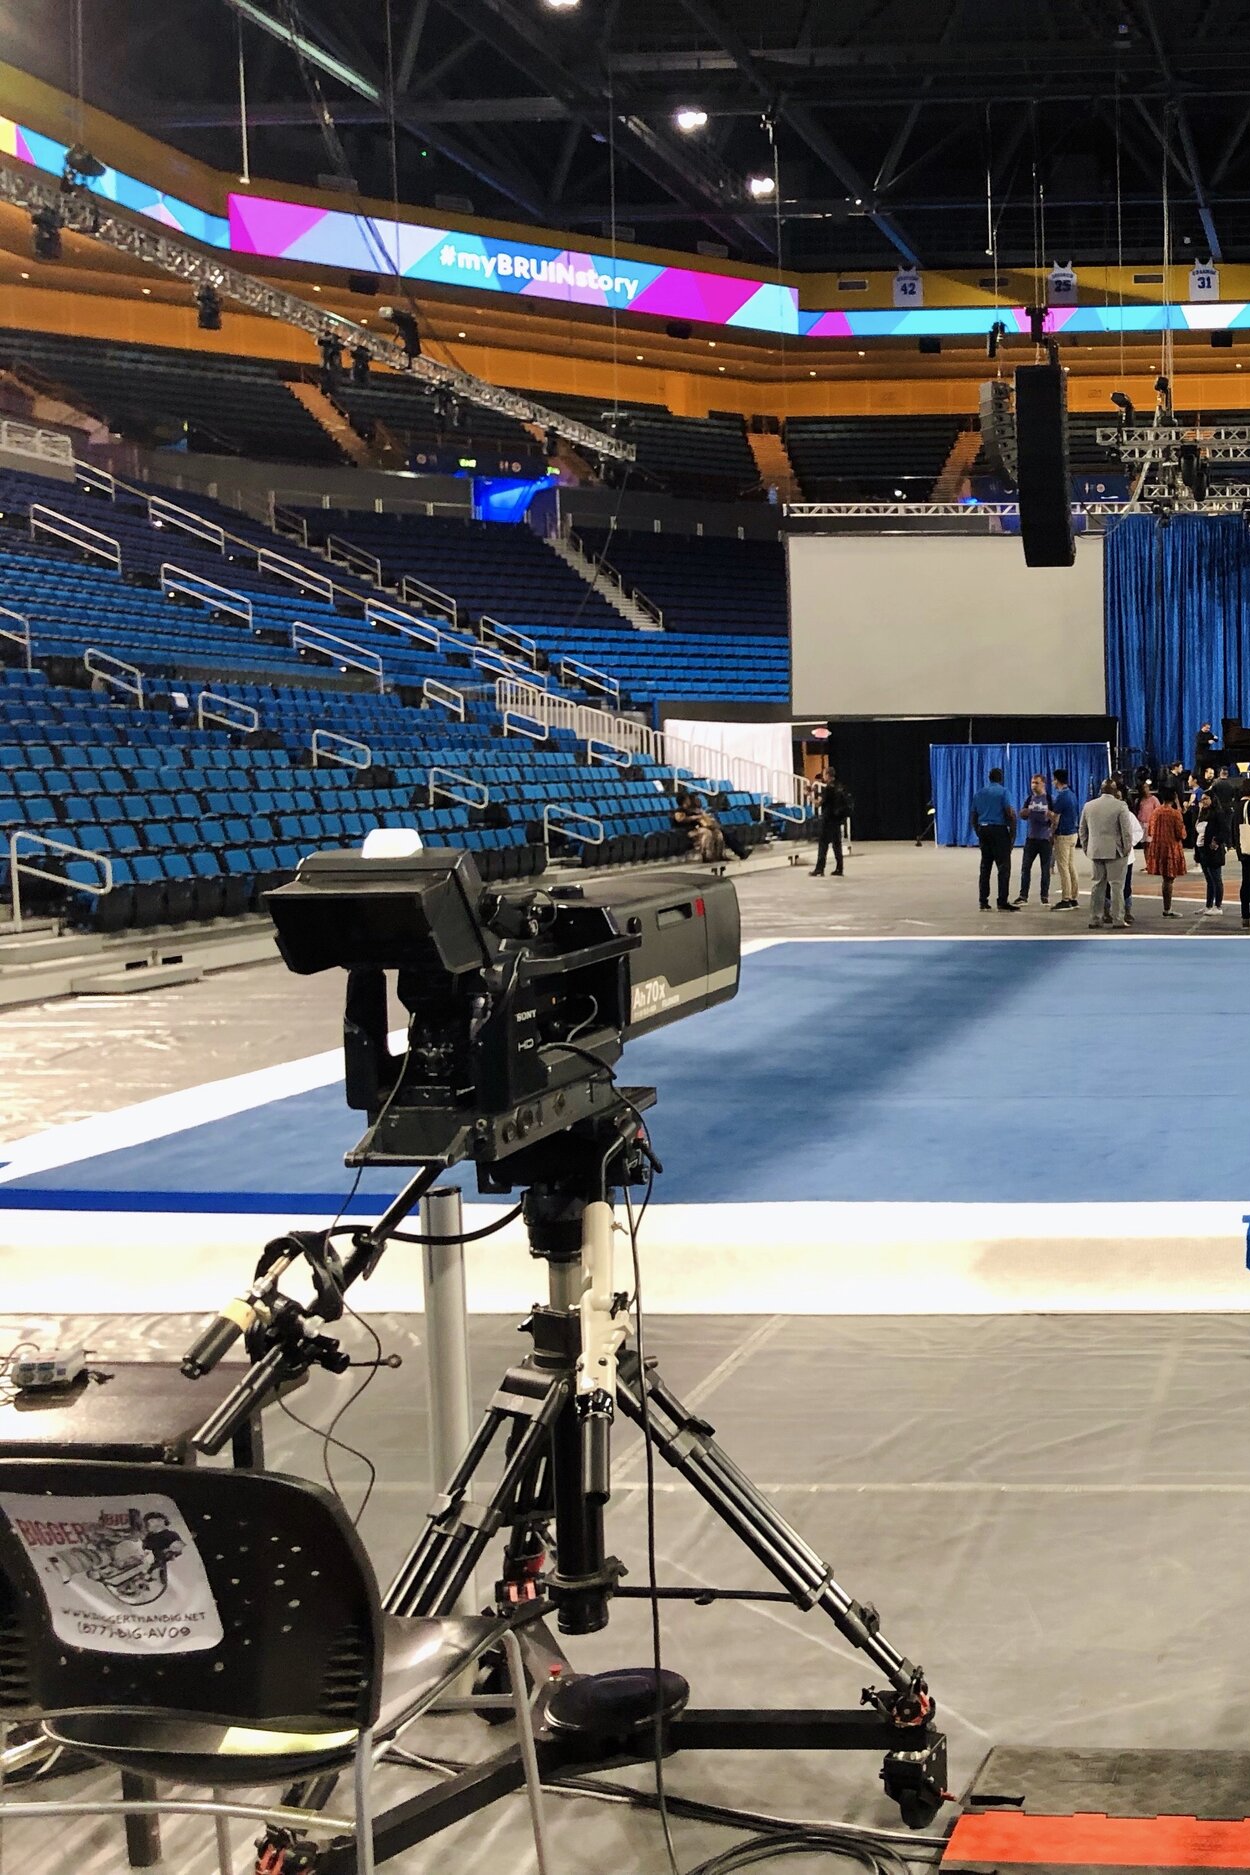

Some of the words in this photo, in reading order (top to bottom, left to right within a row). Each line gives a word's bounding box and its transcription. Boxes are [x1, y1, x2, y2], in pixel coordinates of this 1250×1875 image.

[439, 244, 639, 300] #myBRUINstory
[900, 282, 917, 296] 42
[1197, 275, 1212, 289] 31
[516, 1008, 537, 1022] SONY
